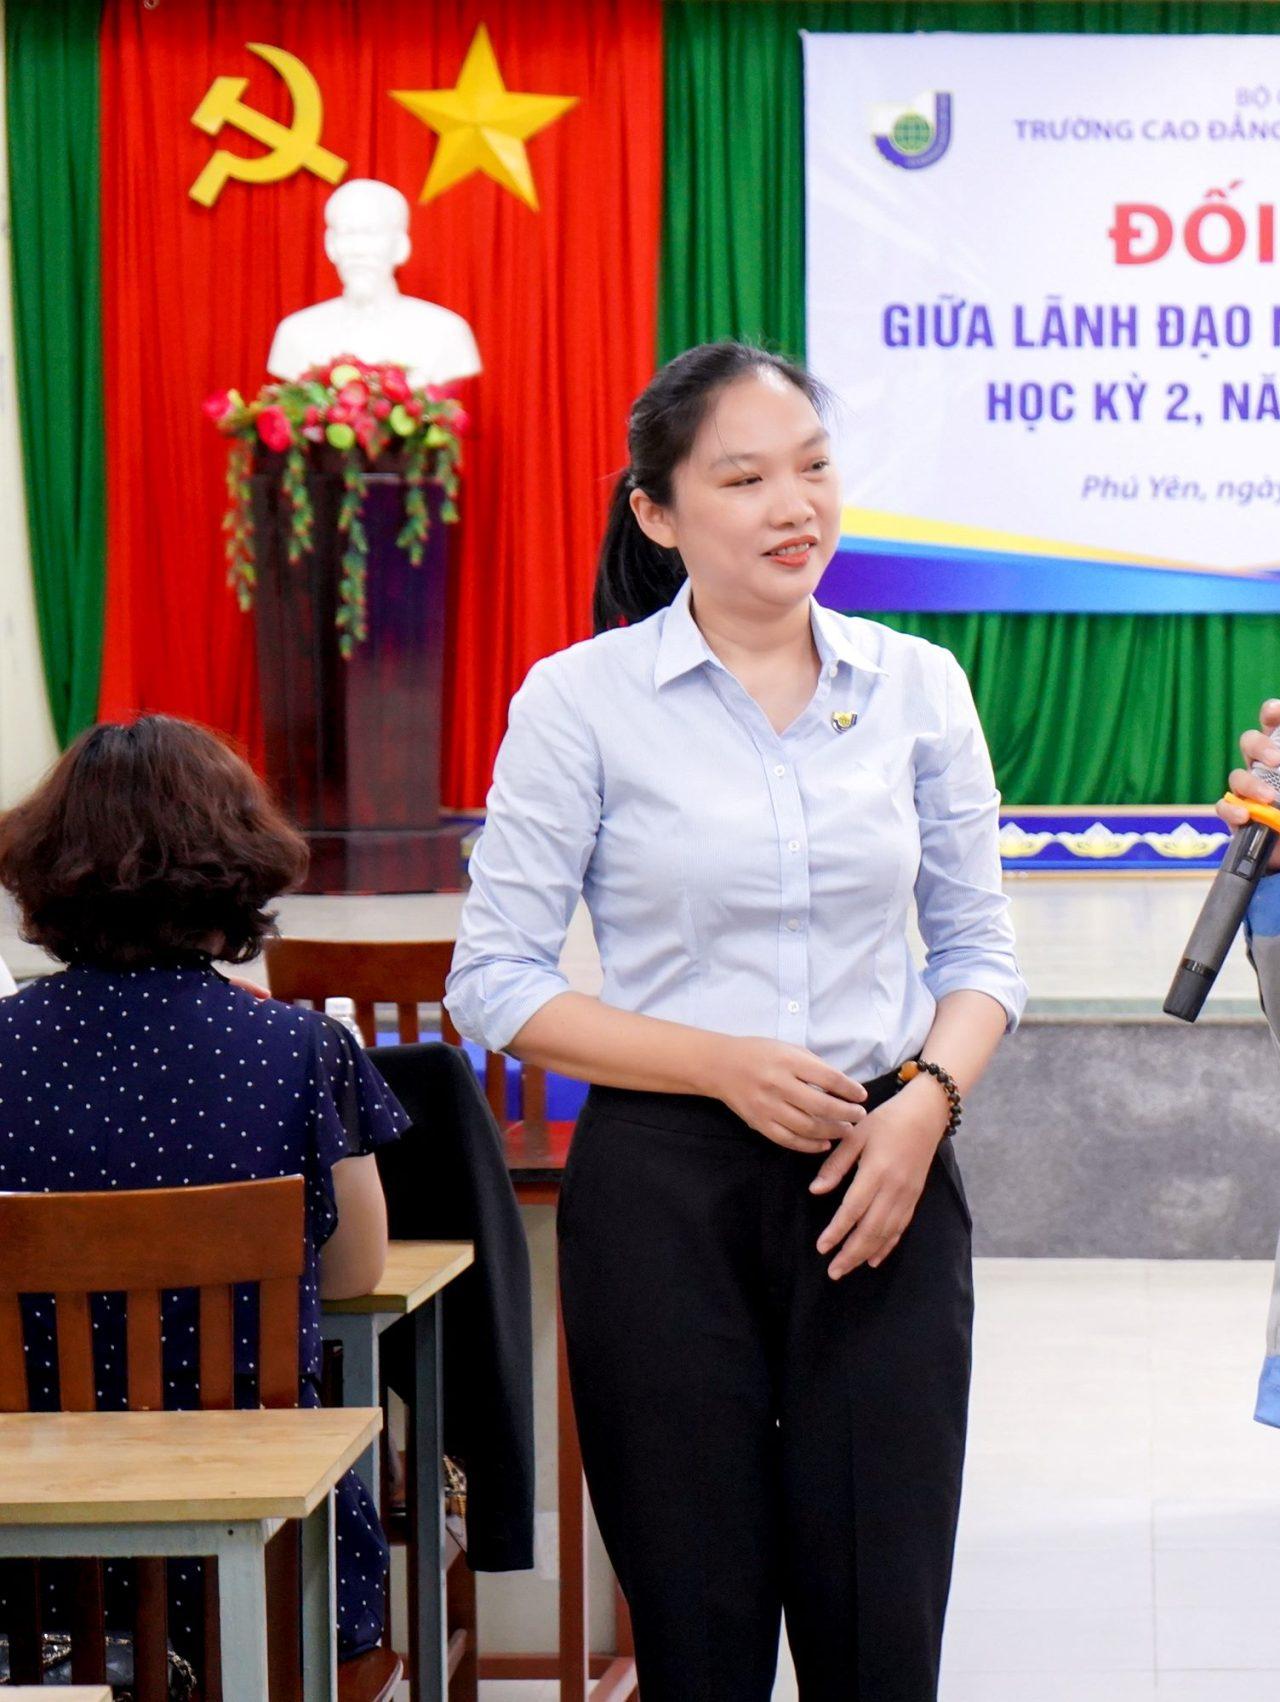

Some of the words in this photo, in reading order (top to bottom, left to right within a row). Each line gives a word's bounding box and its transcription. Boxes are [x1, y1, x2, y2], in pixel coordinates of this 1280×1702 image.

[1014, 114, 1134, 140] TRƯỜNG
[1141, 119, 1200, 140] CAO
[1107, 178, 1275, 265] ĐỐI
[881, 294, 995, 349] GIỮA
[1013, 296, 1137, 348] LÃNH
[1156, 304, 1252, 359] ĐẠO
[986, 382, 1076, 432] HỌC
[1094, 372, 1147, 422] KỲ
[1166, 382, 1203, 427] 2,
[1148, 474, 1207, 502] Yên,
